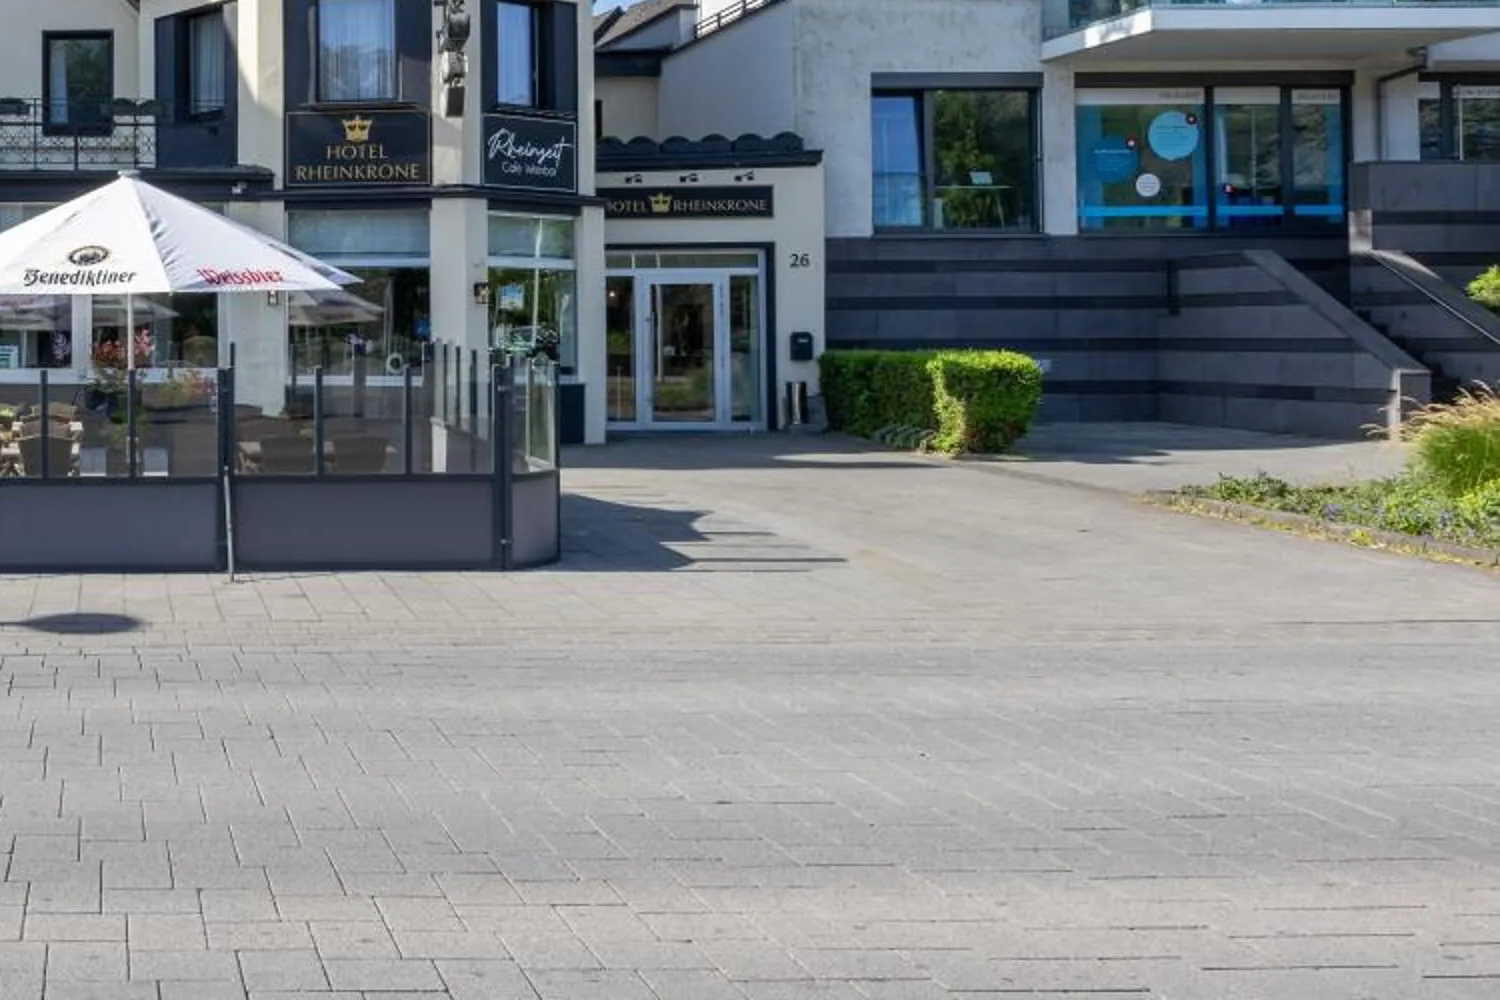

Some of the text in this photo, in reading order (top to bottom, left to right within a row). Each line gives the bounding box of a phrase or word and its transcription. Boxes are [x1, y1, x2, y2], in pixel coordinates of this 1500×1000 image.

[326, 145, 388, 160] HOTEL
[295, 163, 421, 181] RHEINKRONE
[673, 198, 768, 212] RHEINKRONE
[789, 253, 810, 269] 26
[23, 268, 137, 288] Benediktiner
[196, 266, 285, 286] Weissbier
